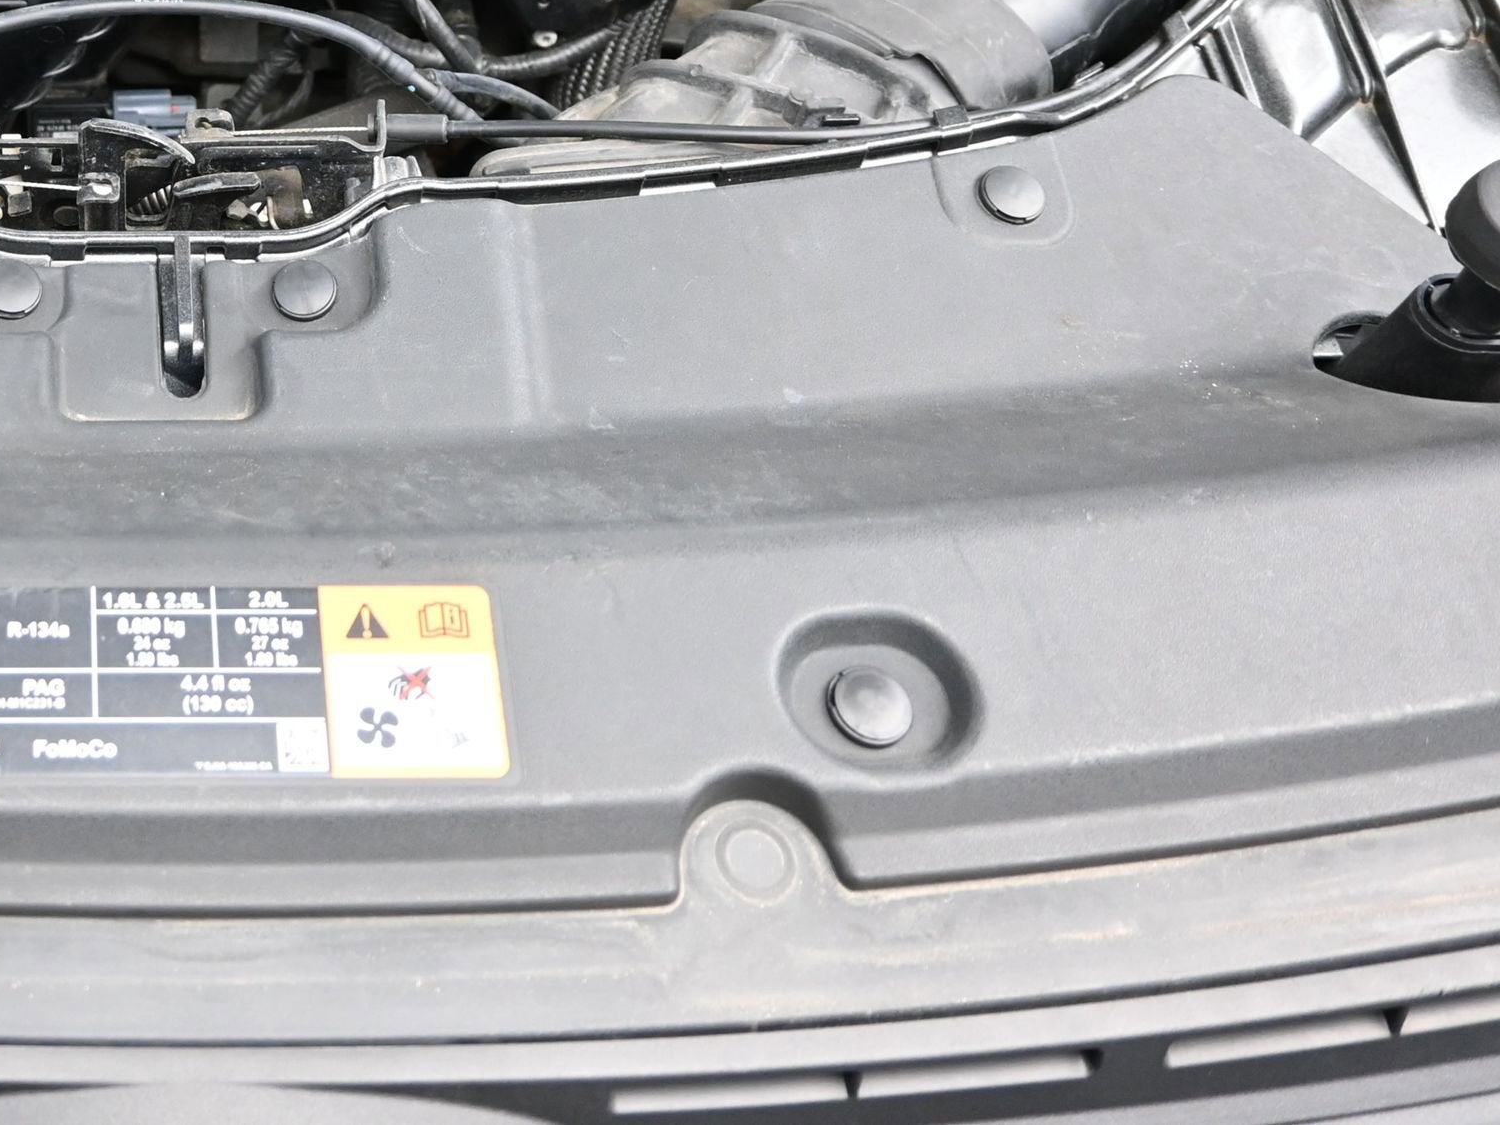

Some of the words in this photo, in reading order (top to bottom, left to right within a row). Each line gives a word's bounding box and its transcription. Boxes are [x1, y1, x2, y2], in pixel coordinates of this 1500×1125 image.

[146, 592, 160, 608] &
[249, 591, 288, 607] 2.0L
[7, 621, 70, 639] R-134a
[164, 618, 185, 637] kg
[235, 617, 279, 634] 0.765
[282, 617, 303, 637] kg
[134, 636, 150, 650] 24
[153, 639, 170, 650] oz
[252, 636, 268, 650] 27
[272, 639, 289, 650] oz
[22, 679, 65, 696] PAG
[181, 675, 208, 691] 4.4
[212, 675, 224, 691] fl
[229, 678, 251, 691] oz
[33, 740, 118, 758] FoMoCo
